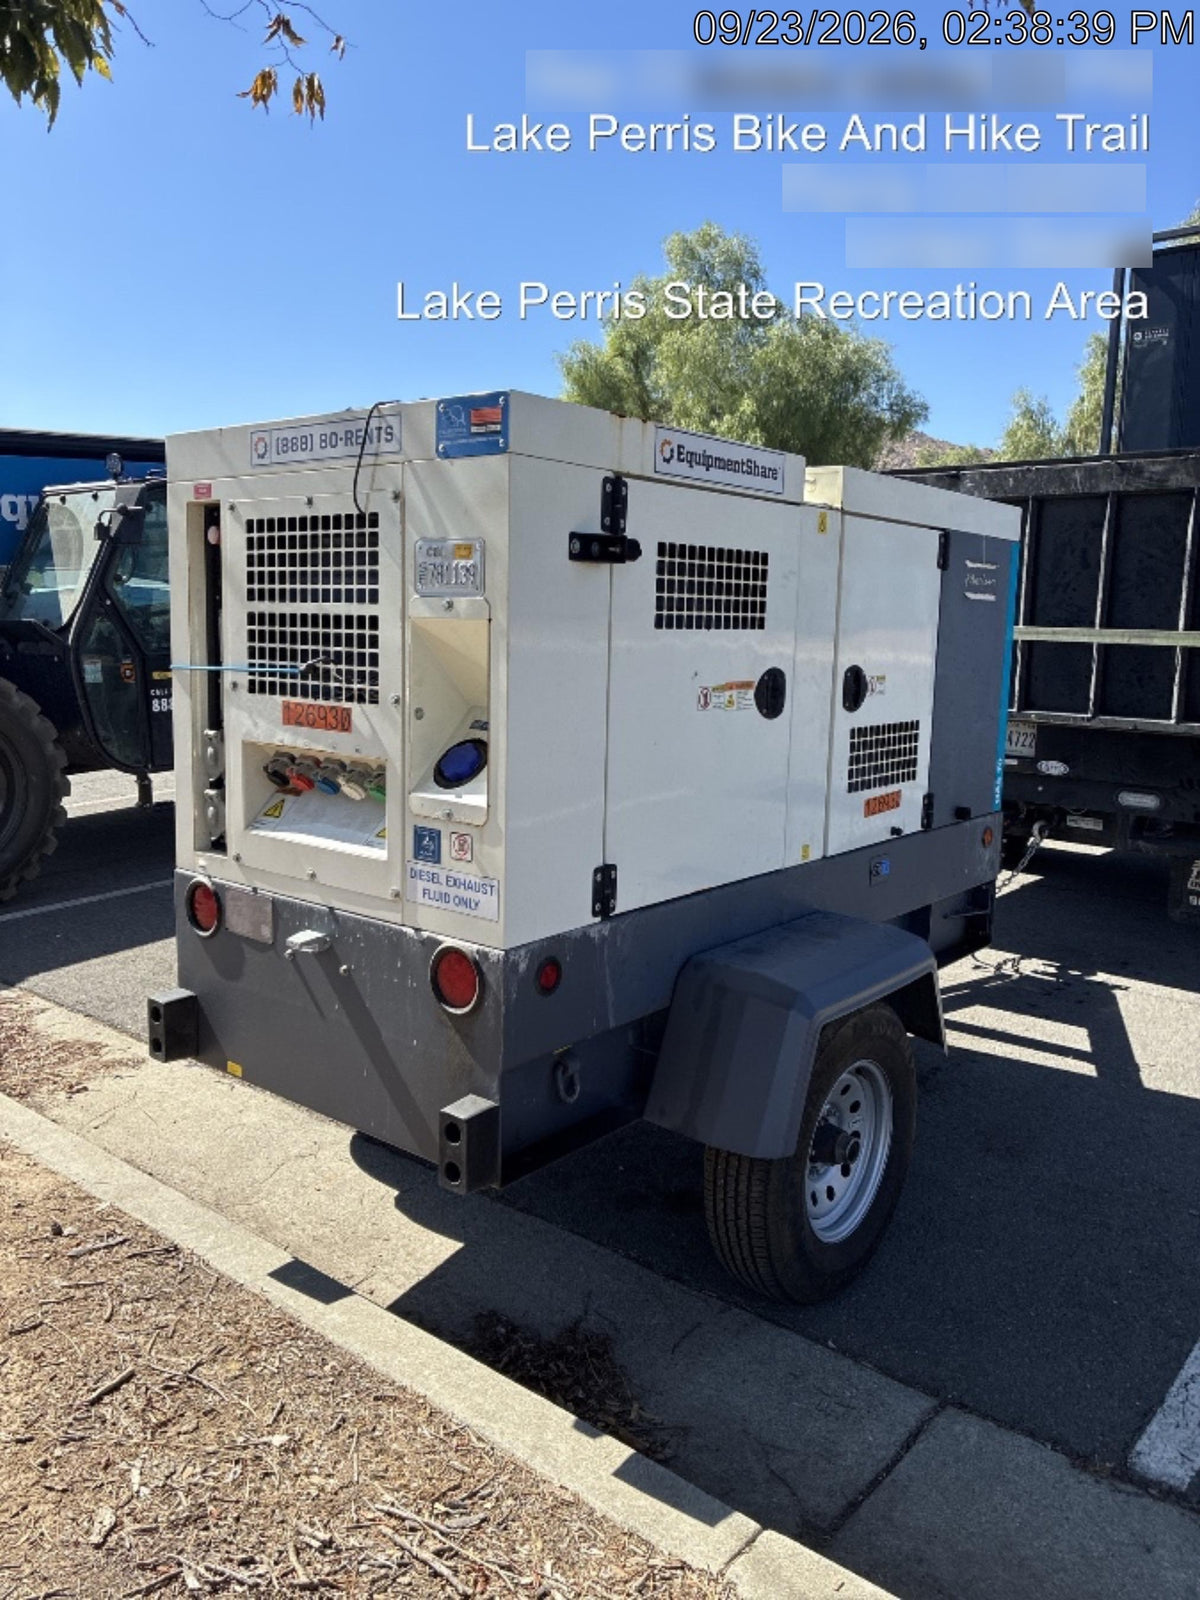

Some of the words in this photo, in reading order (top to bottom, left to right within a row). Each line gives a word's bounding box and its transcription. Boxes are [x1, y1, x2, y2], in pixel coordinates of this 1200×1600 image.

[676, 443, 779, 481] EquipmentShare
[410, 867, 443, 886] DIESEL
[446, 875, 496, 896] EXHAUST
[422, 888, 450, 904] FLUID
[453, 896, 481, 911] ONLY
